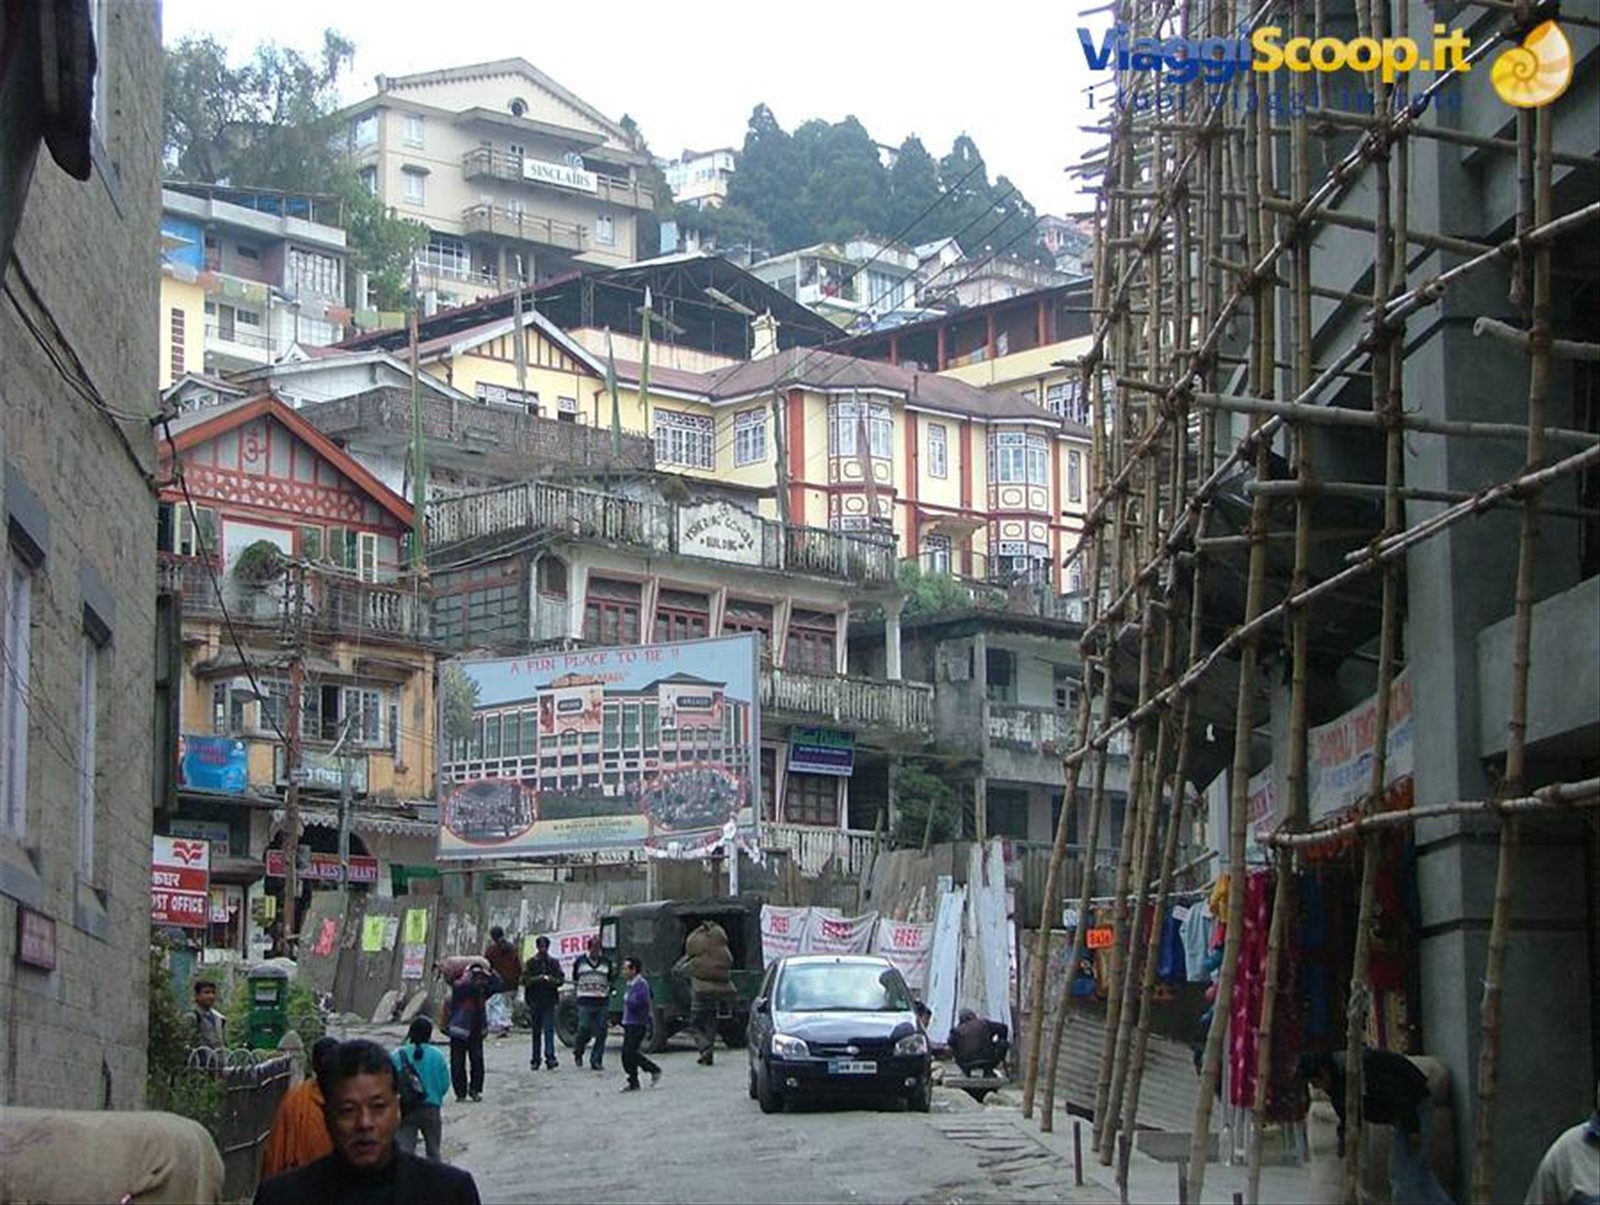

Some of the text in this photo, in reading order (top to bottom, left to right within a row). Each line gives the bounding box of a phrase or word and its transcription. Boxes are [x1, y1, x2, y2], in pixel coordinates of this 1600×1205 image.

[527, 659, 556, 675] FUN
[564, 652, 608, 668] PLACE
[618, 651, 637, 664] TO
[171, 896, 204, 914] OFFICE
[561, 934, 599, 954] FRE
